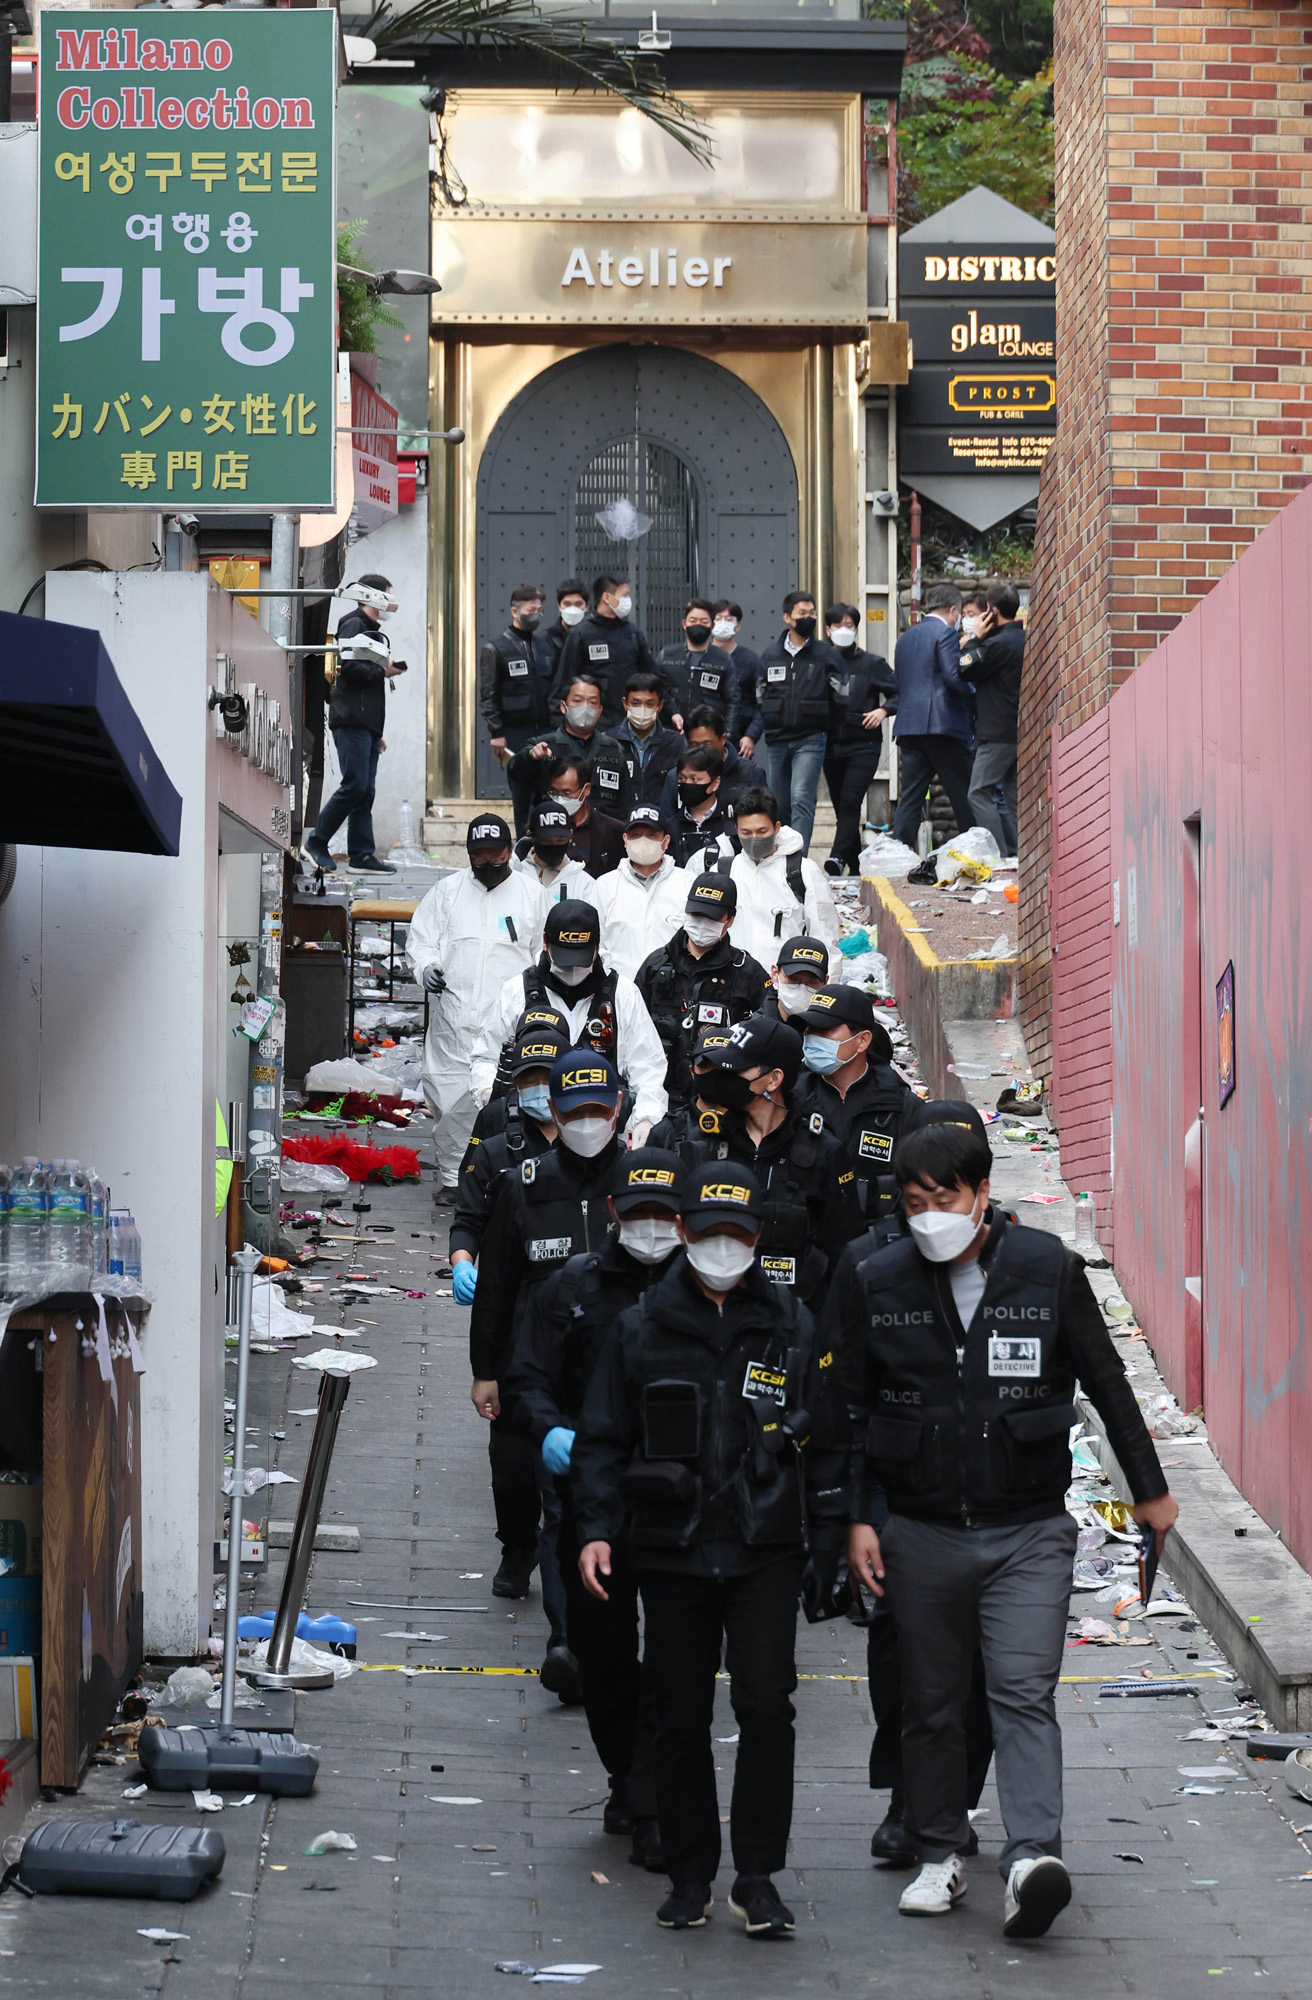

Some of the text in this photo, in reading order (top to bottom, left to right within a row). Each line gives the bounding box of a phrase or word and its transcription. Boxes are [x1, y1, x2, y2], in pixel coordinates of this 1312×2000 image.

[55, 27, 233, 71] Milano
[57, 86, 316, 130] Collection
[54, 151, 318, 194] 여성구두전문
[125, 211, 259, 254] 여행용
[561, 247, 732, 288] Atelier
[59, 267, 315, 367] 가방
[951, 310, 1021, 352] glam
[998, 341, 1053, 357] LOUNGE
[969, 386, 1036, 400] PROST
[359, 457, 379, 479] LUXURY
[370, 483, 390, 504] LOUNGE
[539, 811, 567, 827] NFS
[629, 807, 659, 822] NFS
[472, 825, 500, 840] NFS
[695, 886, 724, 901] KCSI
[559, 931, 591, 941] KCSI
[792, 948, 824, 962] KCSI
[525, 1012, 560, 1025] KCSI
[521, 1044, 558, 1058] KCSI
[561, 1068, 608, 1088] KCSI
[864, 1135, 890, 1148] KCSI
[628, 1168, 675, 1184] KCSI
[701, 1184, 751, 1203] KCSI
[535, 1248, 569, 1260] POLICE
[764, 1260, 792, 1270] KCSI
[871, 1310, 933, 1327] POLICE
[983, 1306, 1051, 1320] POLICE
[993, 1362, 1035, 1371] DETECTIVE
[750, 1368, 787, 1386] KCSI
